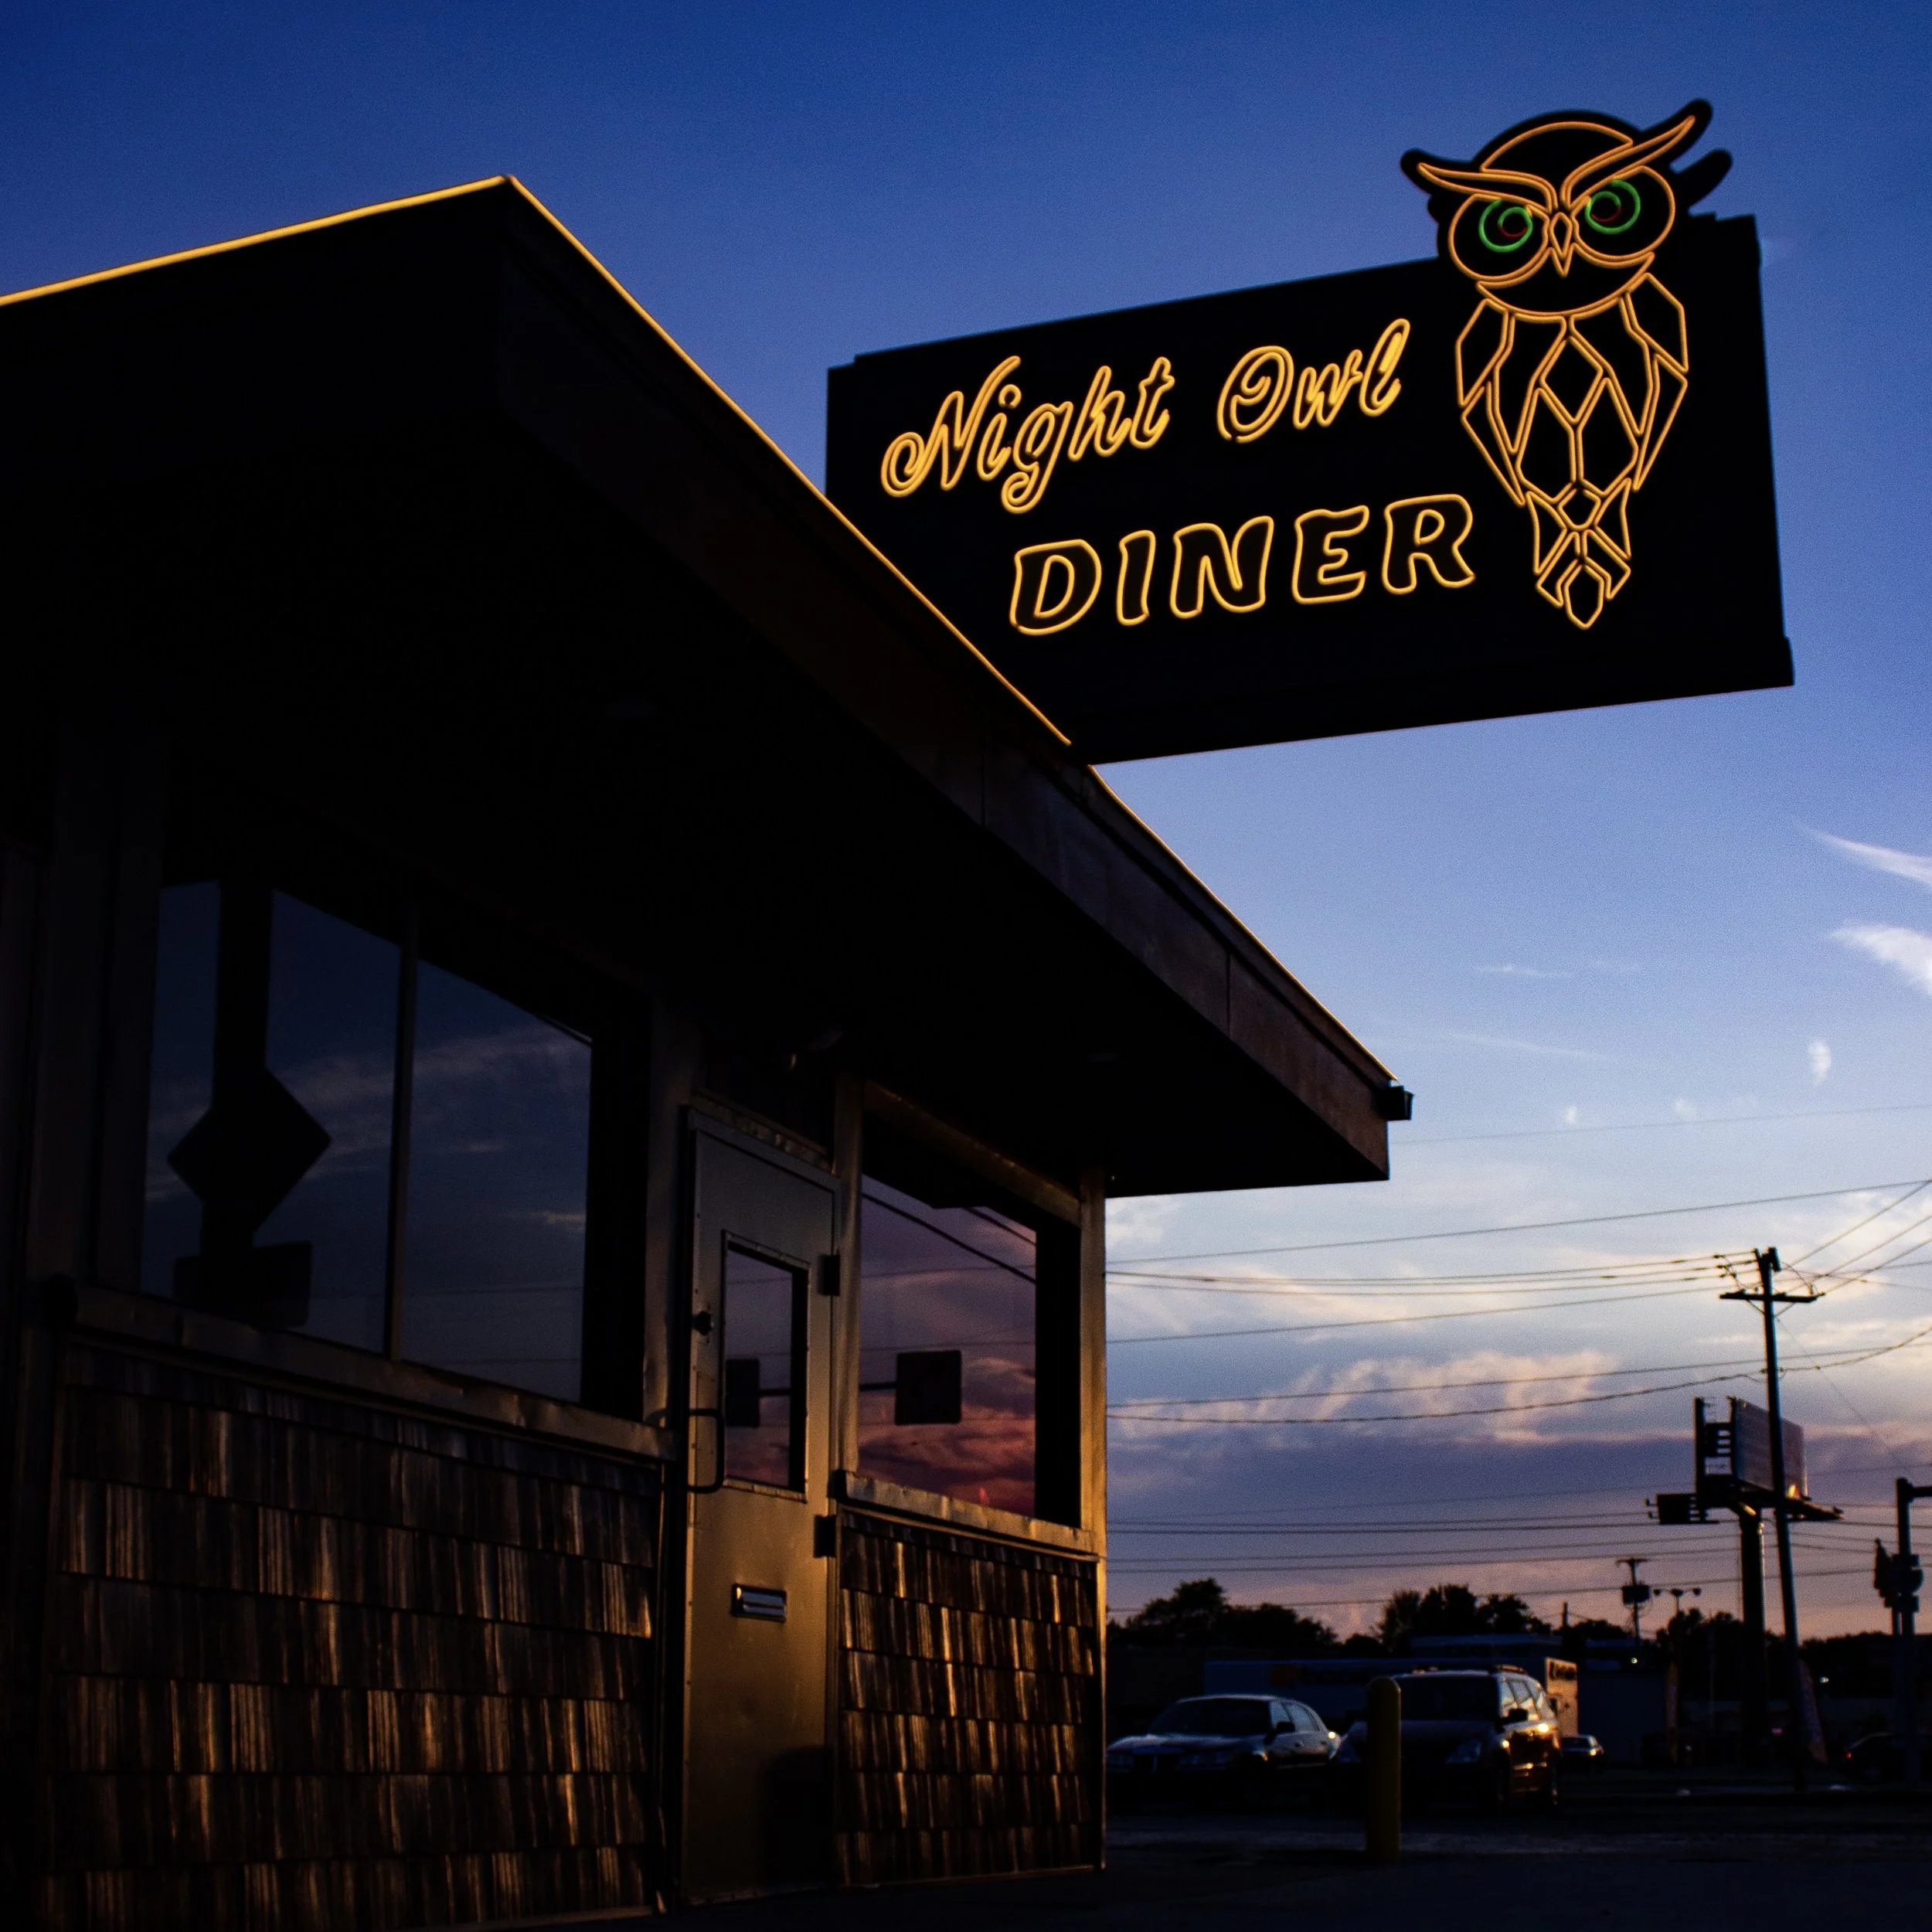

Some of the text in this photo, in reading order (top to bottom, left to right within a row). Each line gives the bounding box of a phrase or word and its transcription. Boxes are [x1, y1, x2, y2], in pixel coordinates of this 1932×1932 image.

[880, 318, 1410, 514] Night Owl
[1009, 494, 1475, 635] DINER
